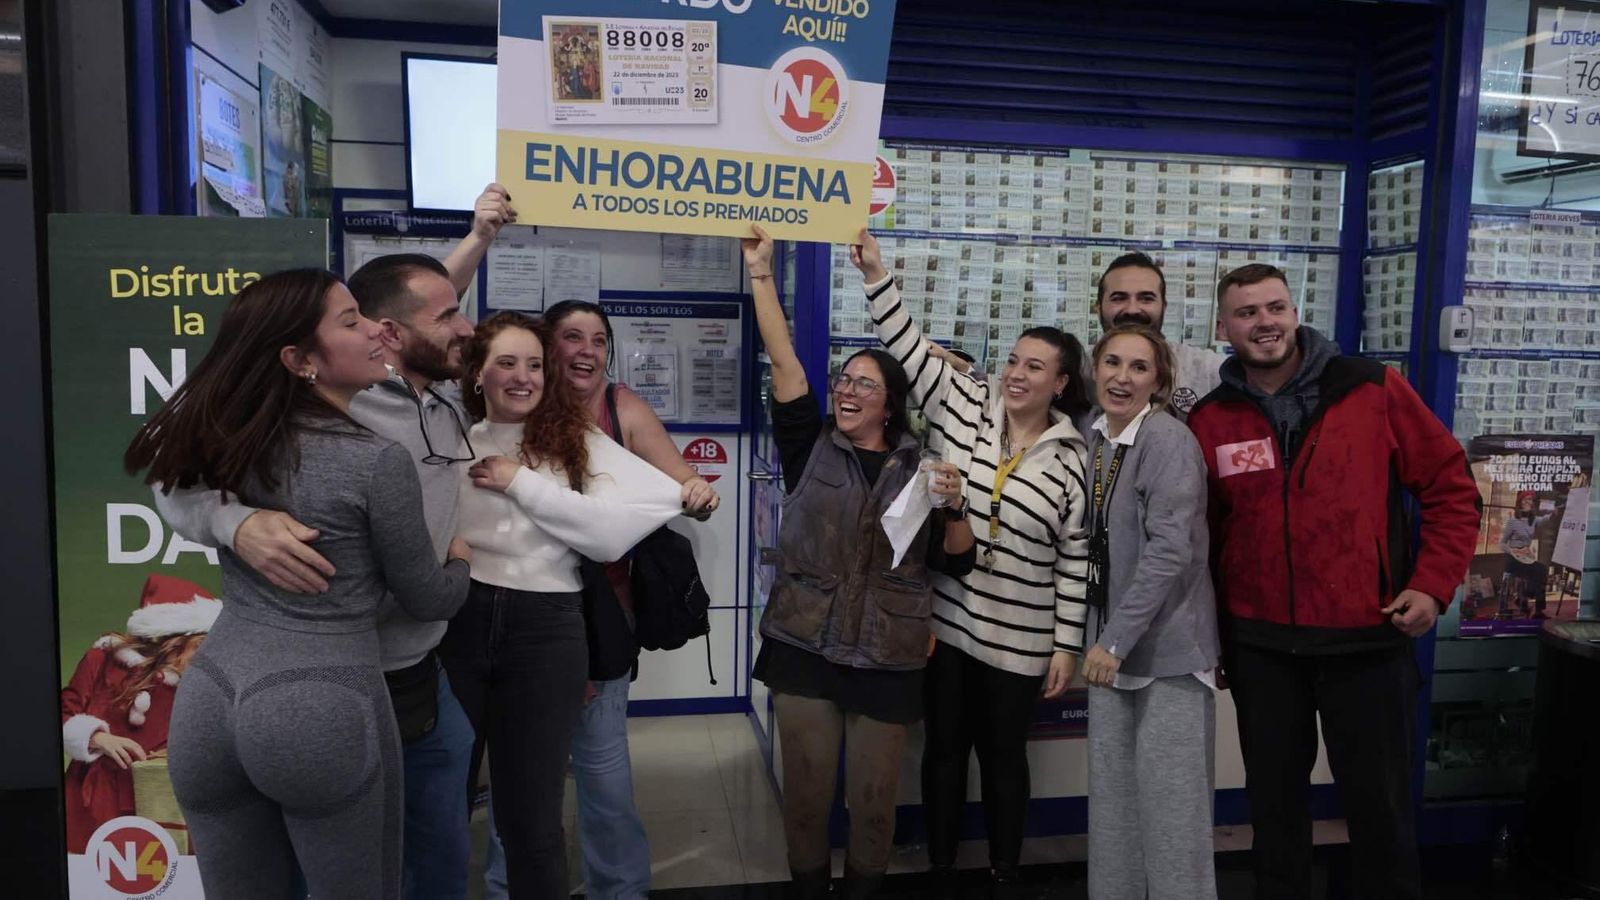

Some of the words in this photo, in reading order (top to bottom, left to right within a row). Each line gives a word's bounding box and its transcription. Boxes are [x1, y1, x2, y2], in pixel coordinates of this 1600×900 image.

[782, 14, 848, 43] AQUÍ!!
[607, 30, 684, 48] 88008
[694, 88, 708, 98] 20
[775, 71, 837, 121] N4
[796, 133, 823, 143] CENTRO
[823, 100, 848, 137] COMERCIAL
[525, 142, 851, 204] ENHORABUENA
[572, 193, 588, 211] A
[591, 194, 659, 215] TODOS
[664, 200, 699, 218] LOS
[703, 203, 809, 225] PREMIADOS
[1558, 214, 1580, 223] JUEVES
[615, 305, 628, 314] DE
[630, 305, 648, 314] LOS
[650, 306, 693, 315] SORTEOS
[173, 305, 205, 336] la
[690, 442, 718, 459] +18
[1483, 464, 1504, 473] MES
[1505, 464, 1534, 474] PARA
[1535, 464, 1581, 474] CUMPLIR
[1529, 455, 1562, 465] EUROS
[1563, 455, 1577, 466] AL
[1539, 473, 1553, 483] DE
[1554, 473, 1574, 483] SER
[1508, 482, 1553, 493] PINTORA
[100, 840, 167, 882] N4
[156, 860, 178, 896] COMERCIAL
